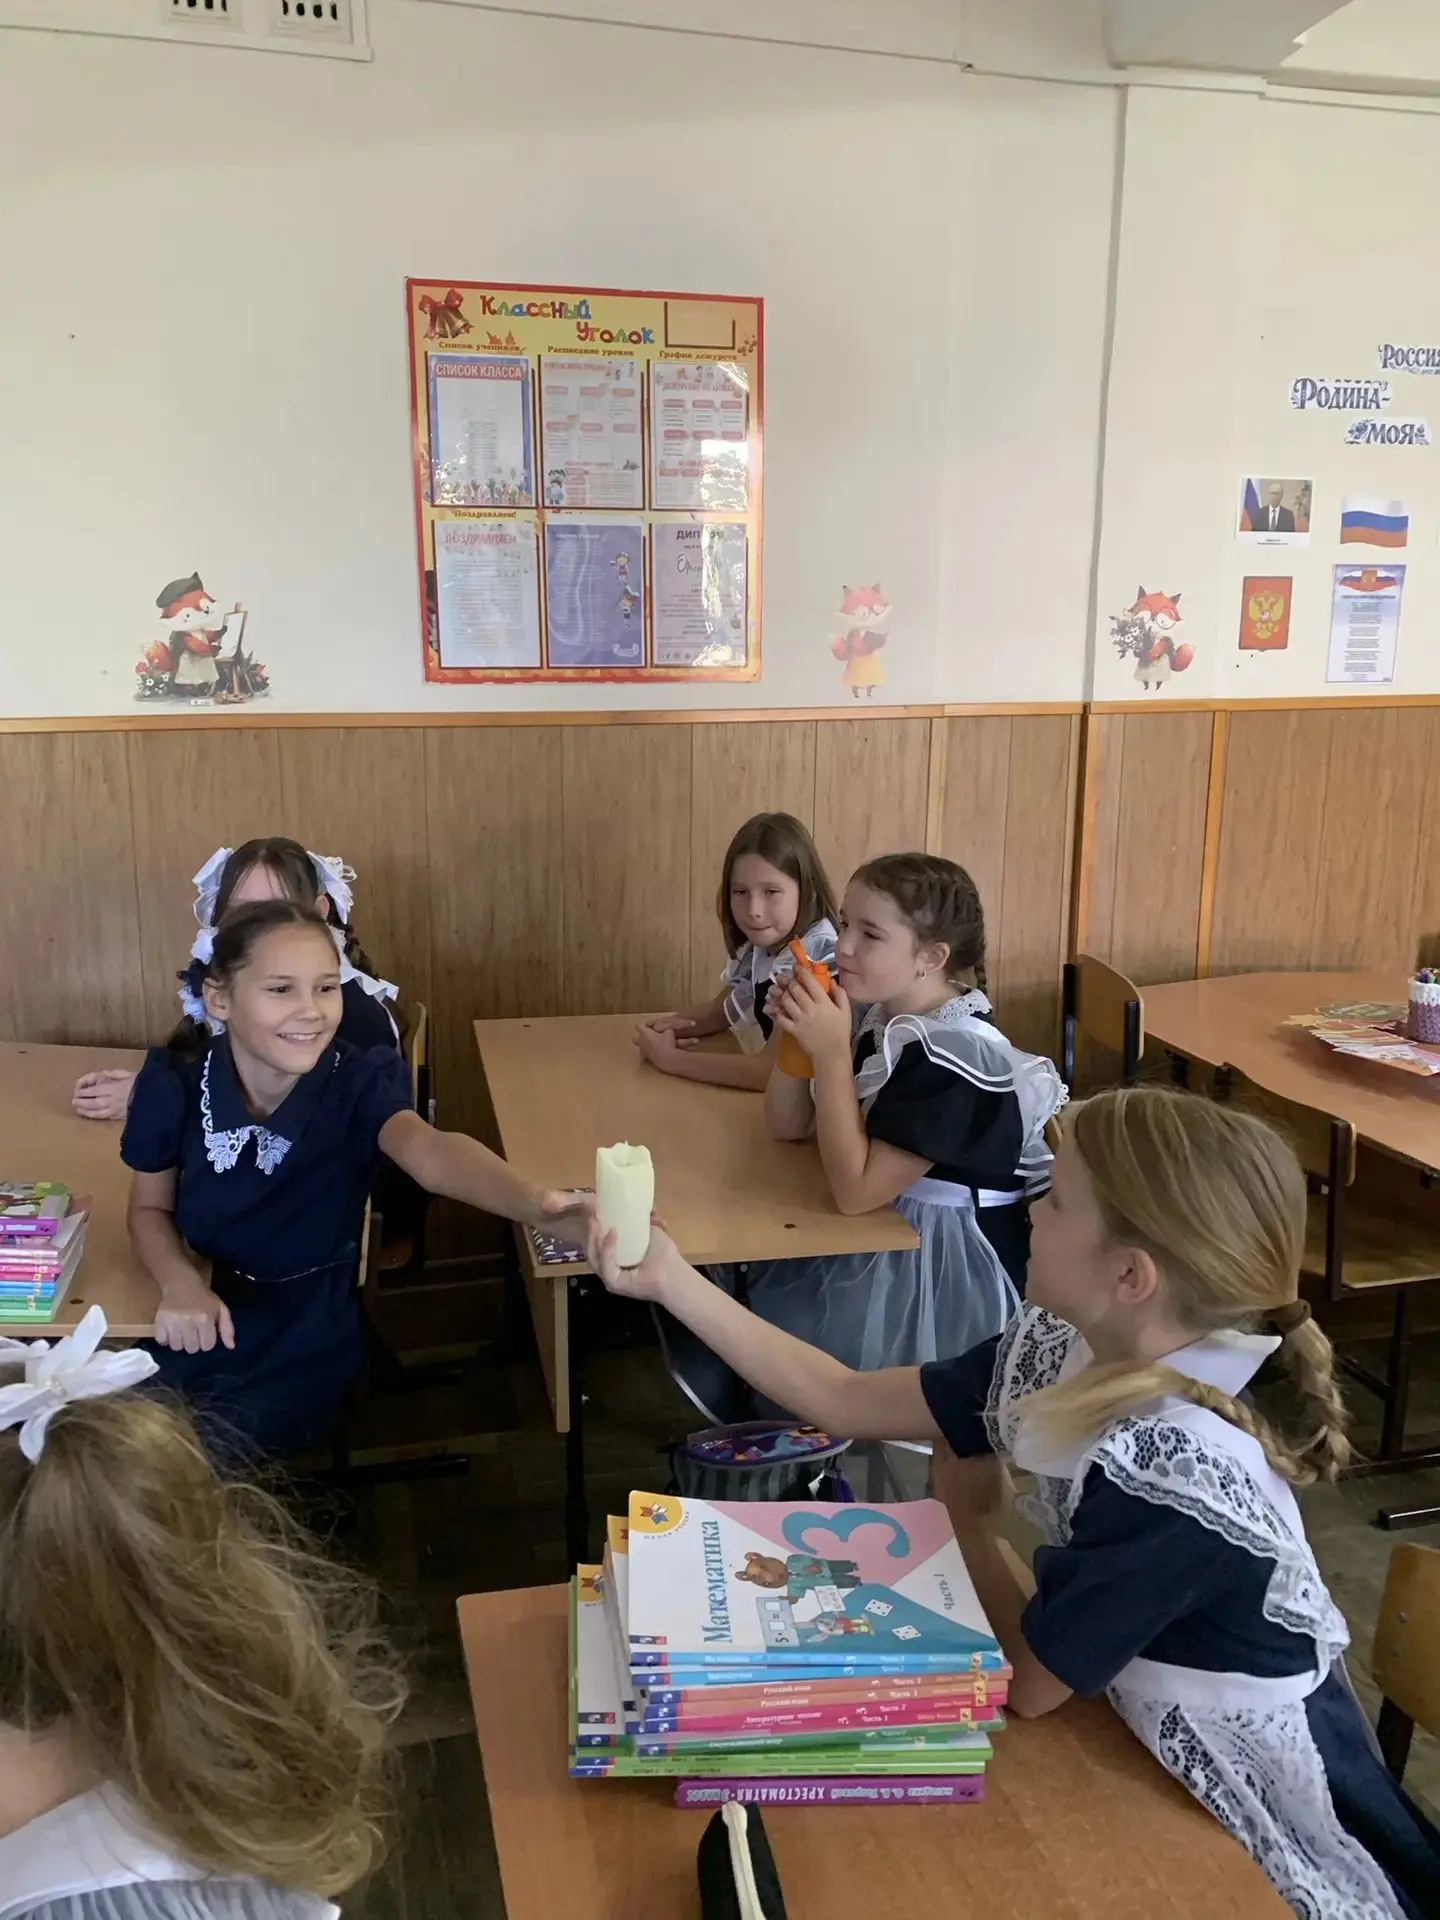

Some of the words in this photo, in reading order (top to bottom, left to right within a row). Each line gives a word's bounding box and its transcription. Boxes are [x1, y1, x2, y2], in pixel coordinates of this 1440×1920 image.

[480, 295, 592, 320] Классный
[576, 321, 654, 345] Уголок
[438, 341, 473, 349] Список
[475, 344, 520, 352] учеников
[548, 345, 600, 355] Расписание
[601, 348, 634, 357] уроков
[659, 350, 692, 359] График
[1381, 344, 1440, 369] РОССИ
[436, 364, 479, 376] СПИСОК
[480, 366, 522, 378] КЛАССА
[1366, 423, 1415, 445] МОЯ
[676, 529, 725, 541] ДИПОМ
[782, 1507, 910, 1559] 3
[702, 1520, 733, 1644] Математика
[937, 1580, 956, 1611] Часть
[737, 1787, 824, 1802] ХРЕСТОМАТИЯ
